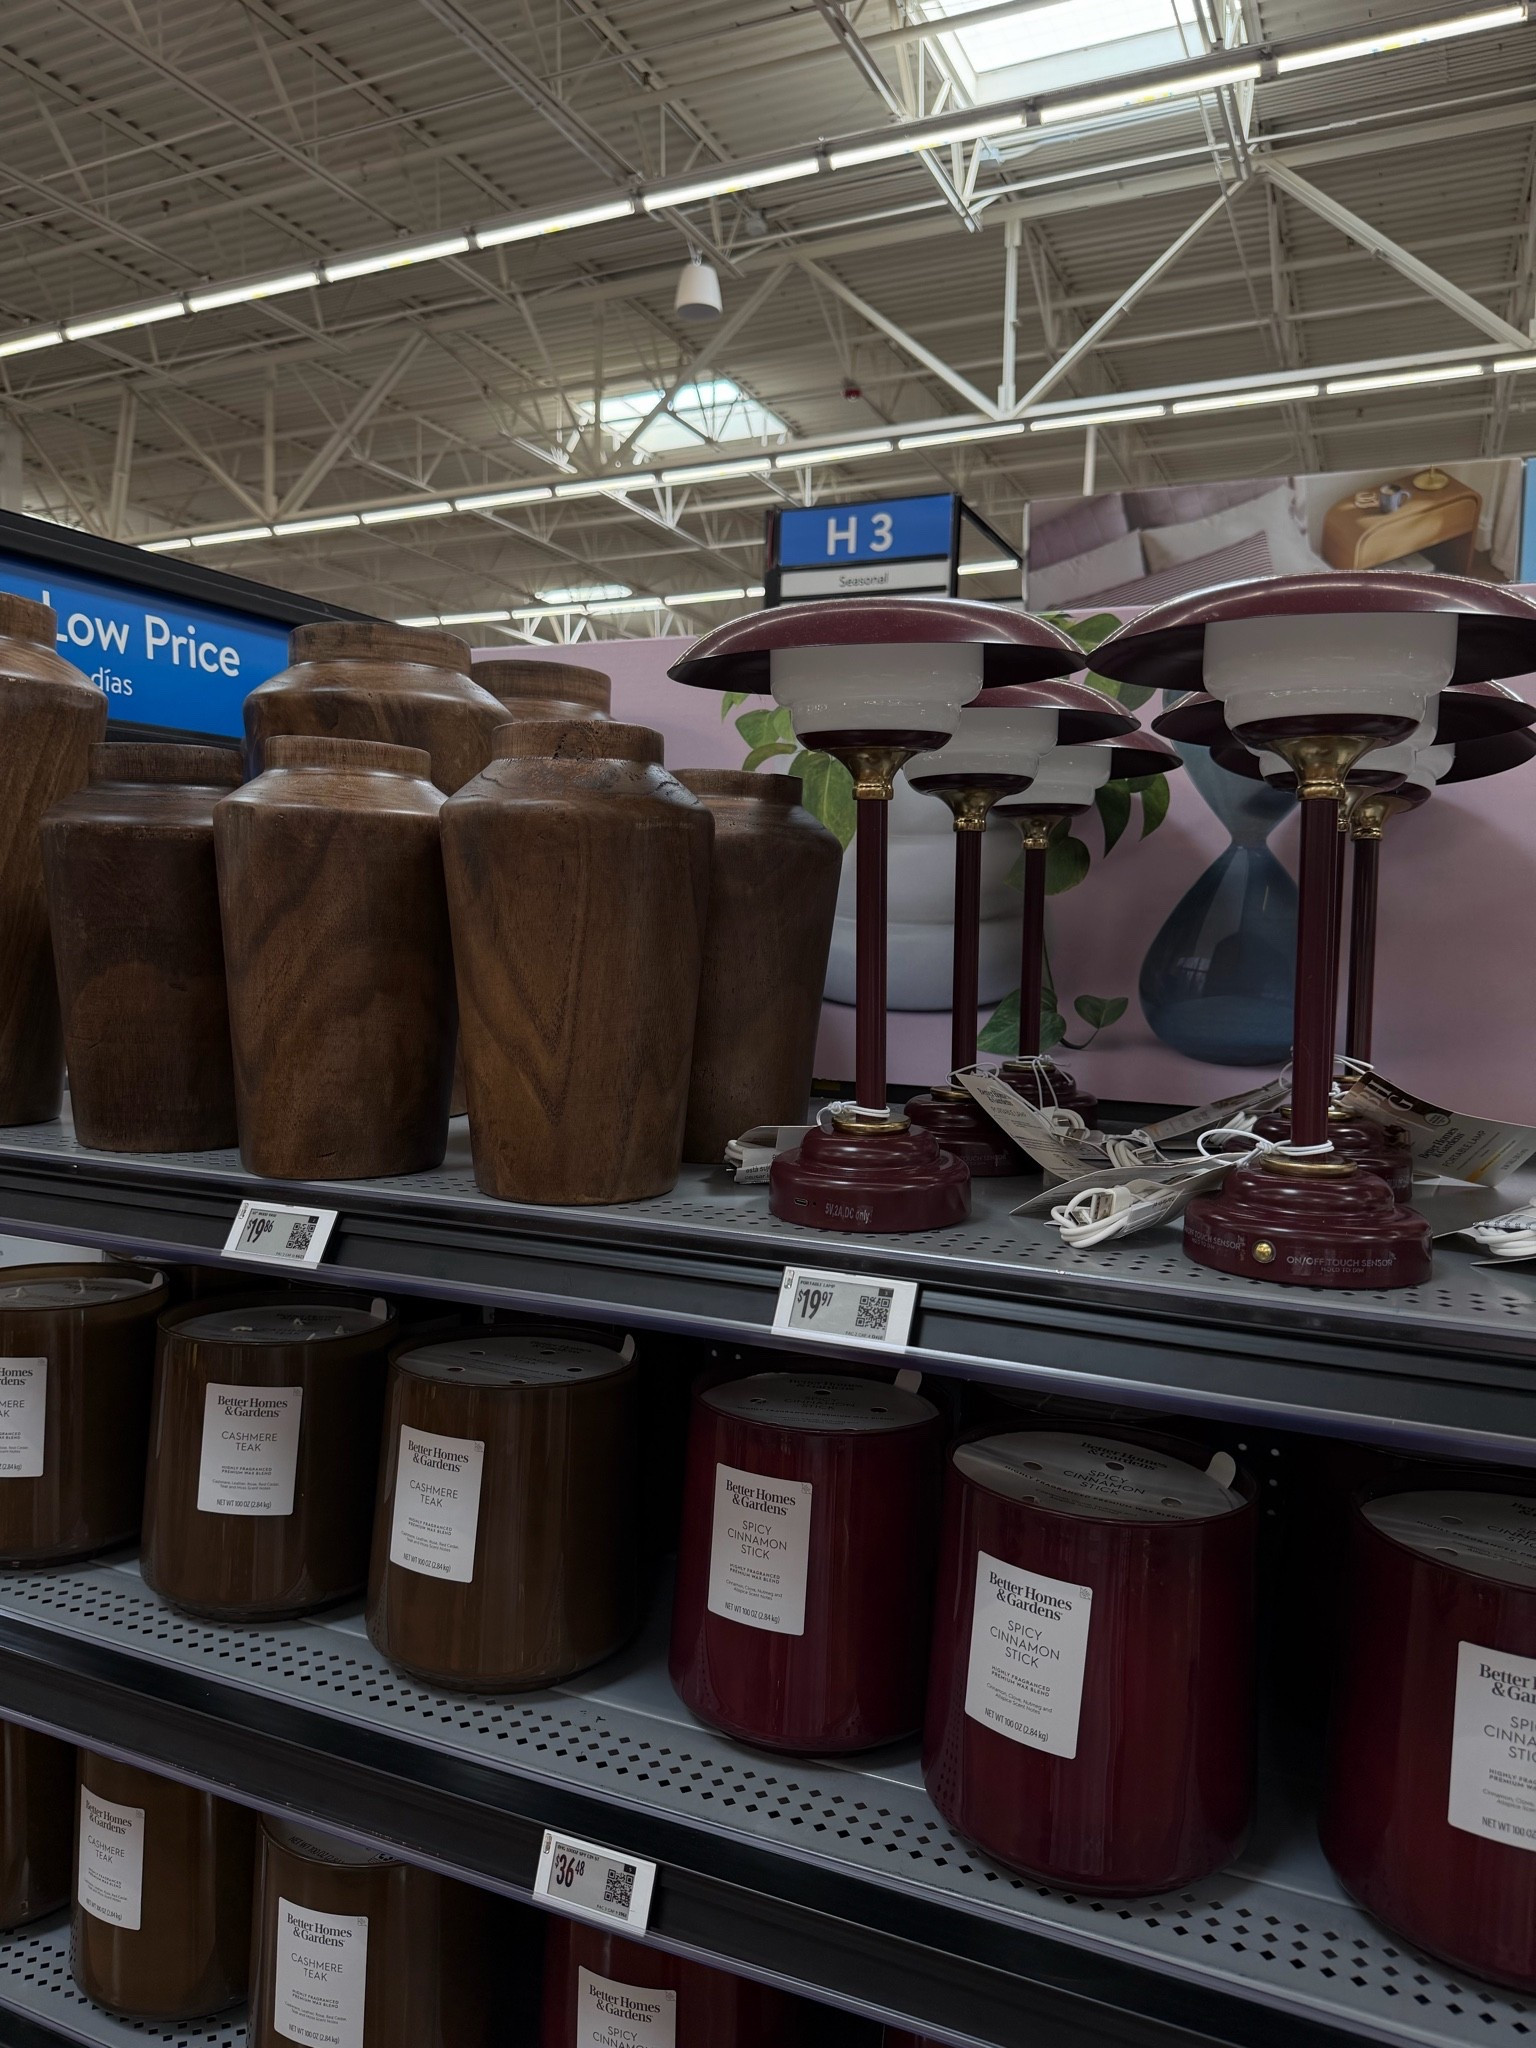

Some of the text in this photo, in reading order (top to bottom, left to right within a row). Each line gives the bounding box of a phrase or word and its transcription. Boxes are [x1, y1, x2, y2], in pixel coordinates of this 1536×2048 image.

[827, 513, 894, 556] H 3
[840, 573, 889, 587] Seasonal
[145, 614, 240, 677] Price
[91, 667, 133, 696] días
[1442, 1143, 1471, 1167] PORTABLE
[1471, 1130, 1486, 1144] LAMP
[1213, 1237, 1240, 1250] SENSOR
[1287, 1256, 1324, 1266] ON/OFF
[0, 1376, 26, 1386] dens
[0, 1400, 24, 1408] MERE
[217, 1395, 288, 1407] Better Homes
[234, 1406, 280, 1417] Gardens
[221, 1430, 278, 1442] CASHMERE
[236, 1442, 261, 1451] TEAK
[408, 1439, 469, 1463] Better Homes
[420, 1454, 460, 1473] Gardens
[1064, 1471, 1145, 1494] CINNAMON
[1089, 1470, 1128, 1483] SPICY
[409, 1478, 458, 1500] CASHMERE
[726, 1479, 796, 1505] Better Homes
[1080, 1482, 1117, 1495] STICK
[216, 1498, 226, 1506] NET
[263, 1501, 272, 1509] kg)
[420, 1493, 443, 1508] TEAK
[741, 1495, 787, 1516] Gardens
[727, 1526, 787, 1551] CINNAMON
[742, 1519, 771, 1536] SPICY
[741, 1543, 770, 1560] STICK
[746, 1567, 780, 1580] FRAGRANCED
[989, 1570, 1073, 1611] Better Homes
[725, 1601, 780, 1625] NET WT 100 OZ (2.84 kg)
[1006, 1591, 1061, 1622] Gardens
[1007, 1619, 1042, 1642] SPICY
[990, 1624, 1060, 1662] CINNAMON
[1005, 1645, 1039, 1669] STICK
[991, 1664, 1050, 1693] HIGHLY FRAGRANCED
[991, 1669, 1049, 1698] PREMIUM WAX BLEND
[1479, 1663, 1530, 1688] Better
[984, 1706, 1048, 1744] NET WT 100 OZ (2.84 kg)
[1510, 1715, 1536, 1733] SPI
[1484, 1723, 1536, 1748] CINNA
[103, 1809, 132, 1828] Homes
[1482, 1815, 1524, 1837] NET WT 100
[87, 1831, 125, 1860] CASHMERE
[95, 1847, 112, 1865] TEAK
[287, 1912, 352, 1939] Better Homes
[301, 1928, 344, 1949] Gardens
[291, 1949, 343, 1975] CASHMERE
[303, 1966, 328, 1983] TEAK
[589, 1983, 661, 2013] Better Homes
[605, 2000, 652, 2024] Gardens
[592, 2032, 656, 2048] CINNA
[607, 2024, 638, 2043] SPICY
